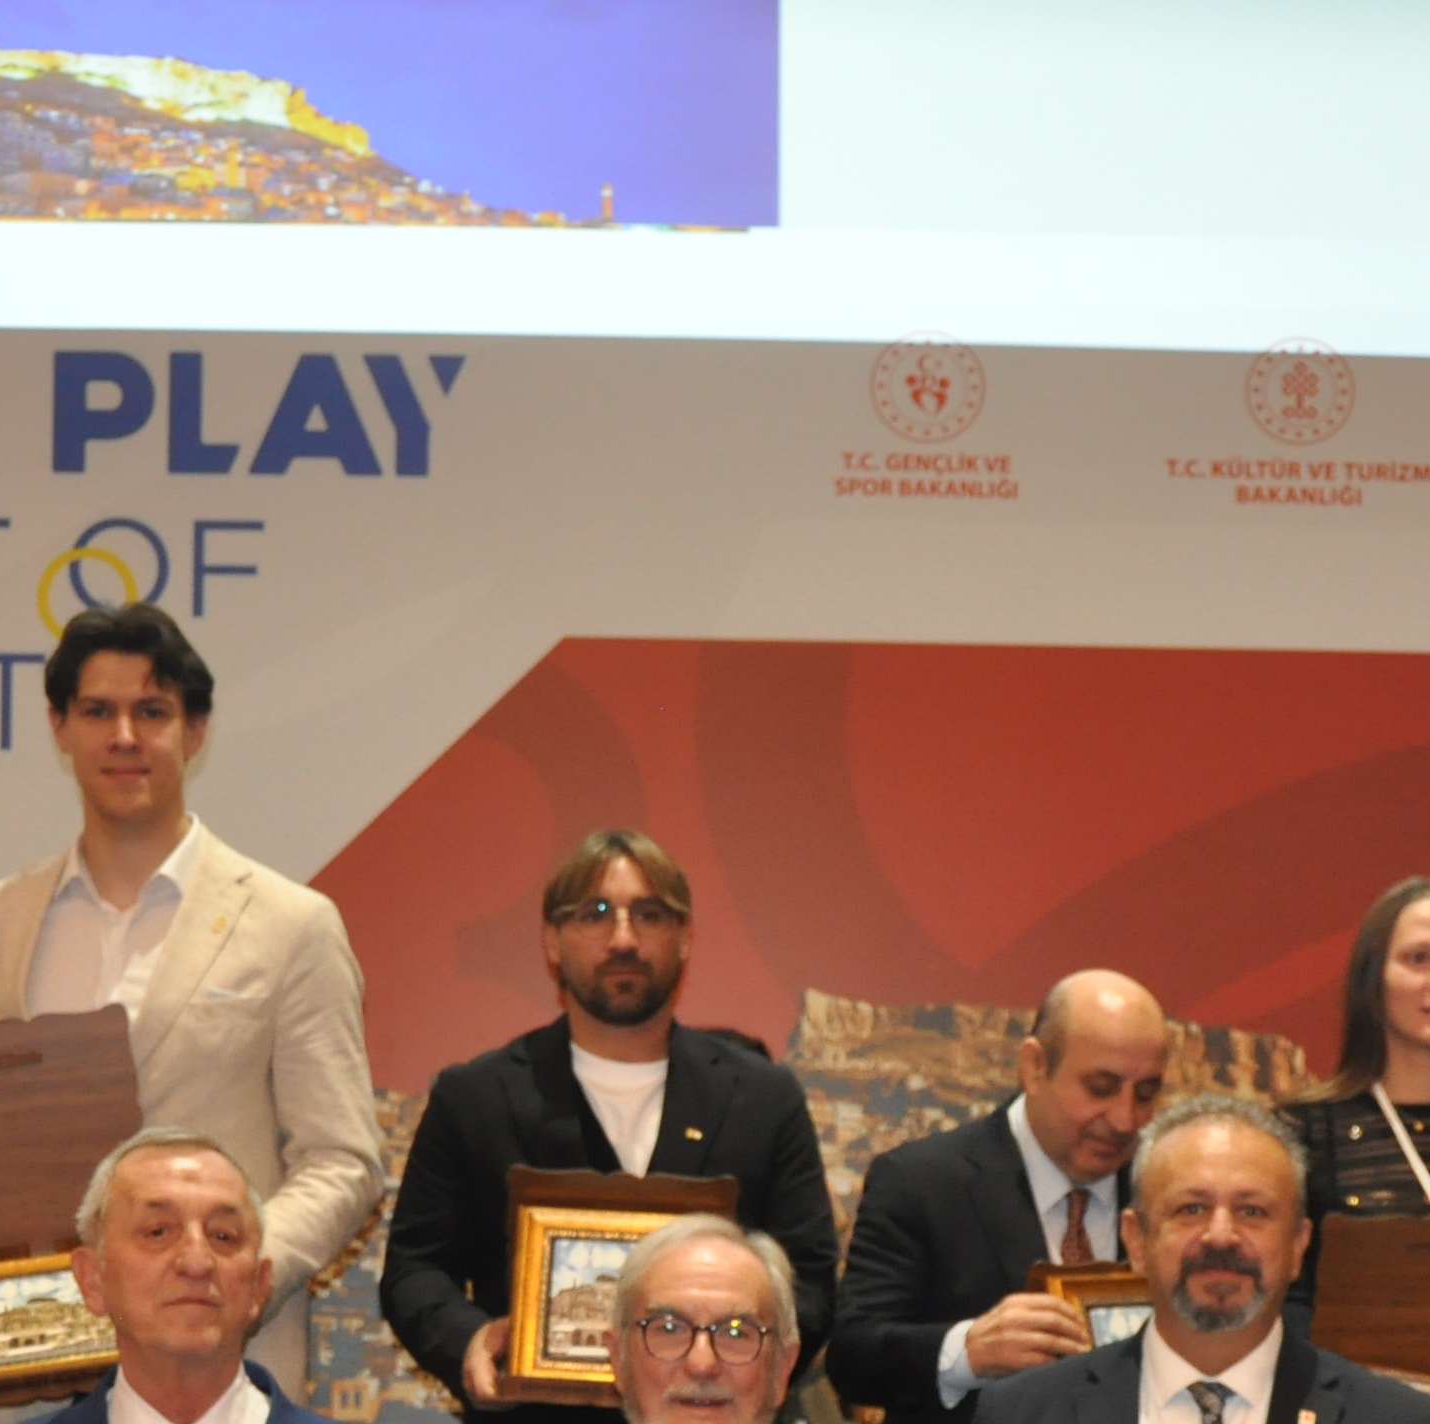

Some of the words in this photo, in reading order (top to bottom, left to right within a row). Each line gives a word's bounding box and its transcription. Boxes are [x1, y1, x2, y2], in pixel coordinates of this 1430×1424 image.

[52, 349, 467, 477] PLAY
[842, 451, 881, 471] T.C.
[885, 451, 978, 475] GENÇLİK
[985, 455, 1012, 473] VE
[1166, 458, 1205, 479] T.C.
[1211, 457, 1302, 481] KÜLTÜR
[1308, 461, 1335, 480] VE
[835, 478, 893, 497] SPOR
[899, 476, 1020, 500] BAKANLIĞI
[1235, 483, 1363, 506] BAKANLIĞI
[69, 516, 265, 617] OF
